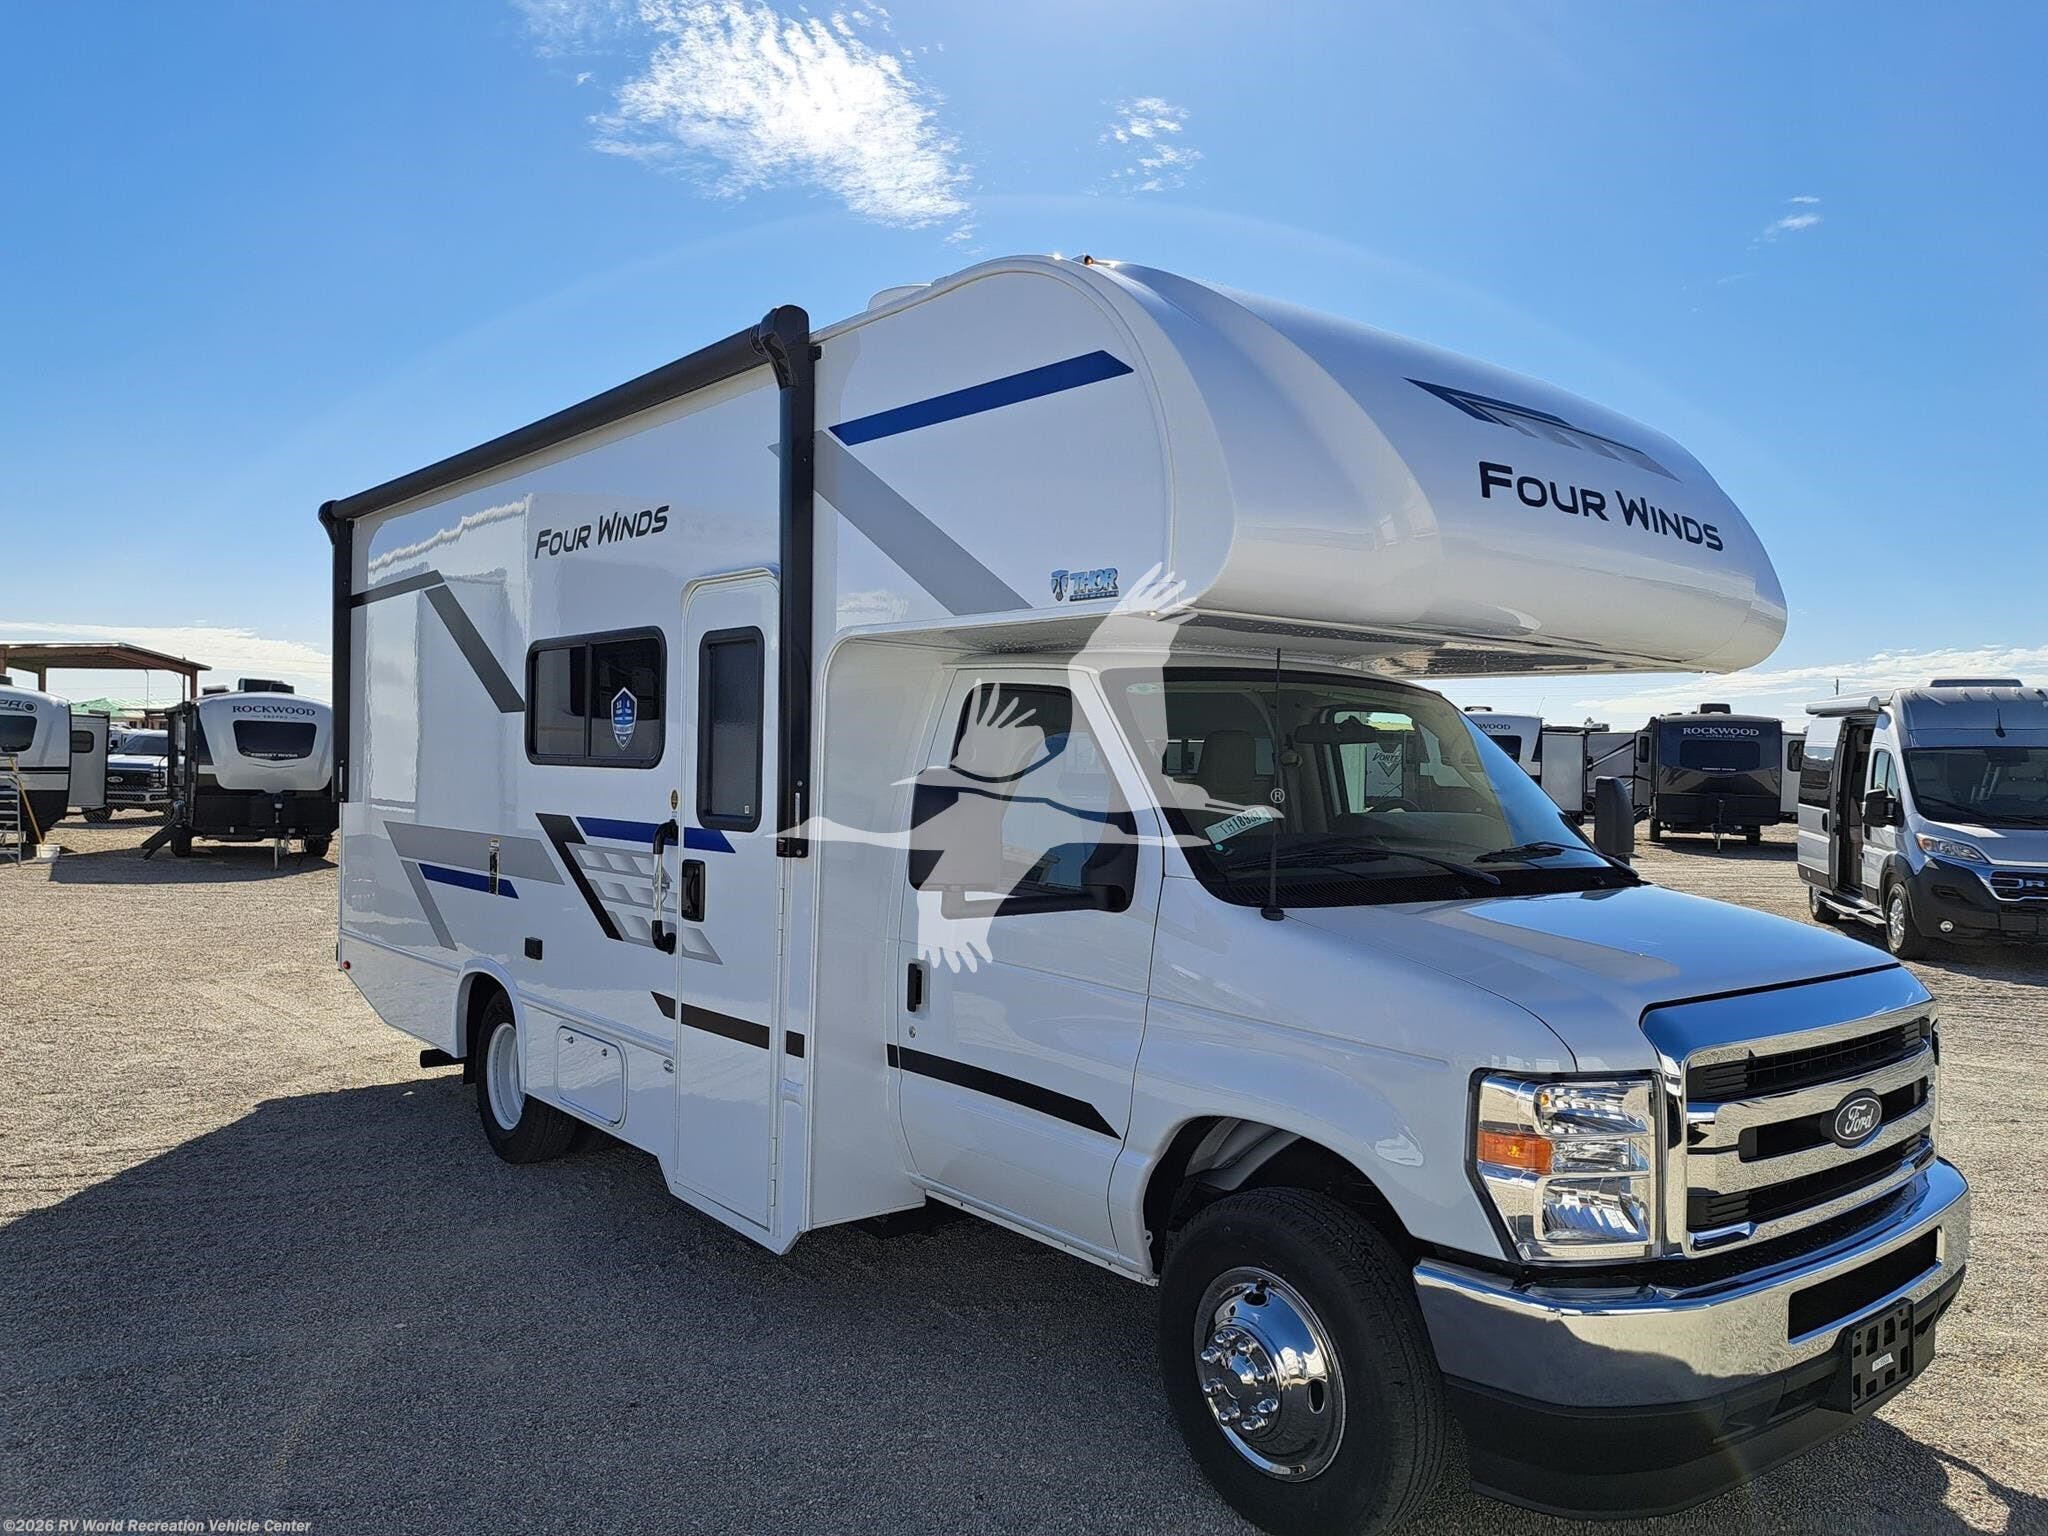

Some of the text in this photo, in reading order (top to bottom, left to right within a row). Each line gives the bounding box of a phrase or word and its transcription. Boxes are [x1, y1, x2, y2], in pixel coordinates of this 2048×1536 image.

[1478, 461, 1723, 552] FOUR WINDS
[534, 504, 670, 560] FOUR WINDS
[1070, 568, 1119, 594] THOR
[232, 705, 316, 717] ROCKWOOD
[1683, 727, 1760, 736] ROCKWOOD
[1372, 752, 1401, 762] VORTE
[1845, 1104, 1874, 1134] Ford
